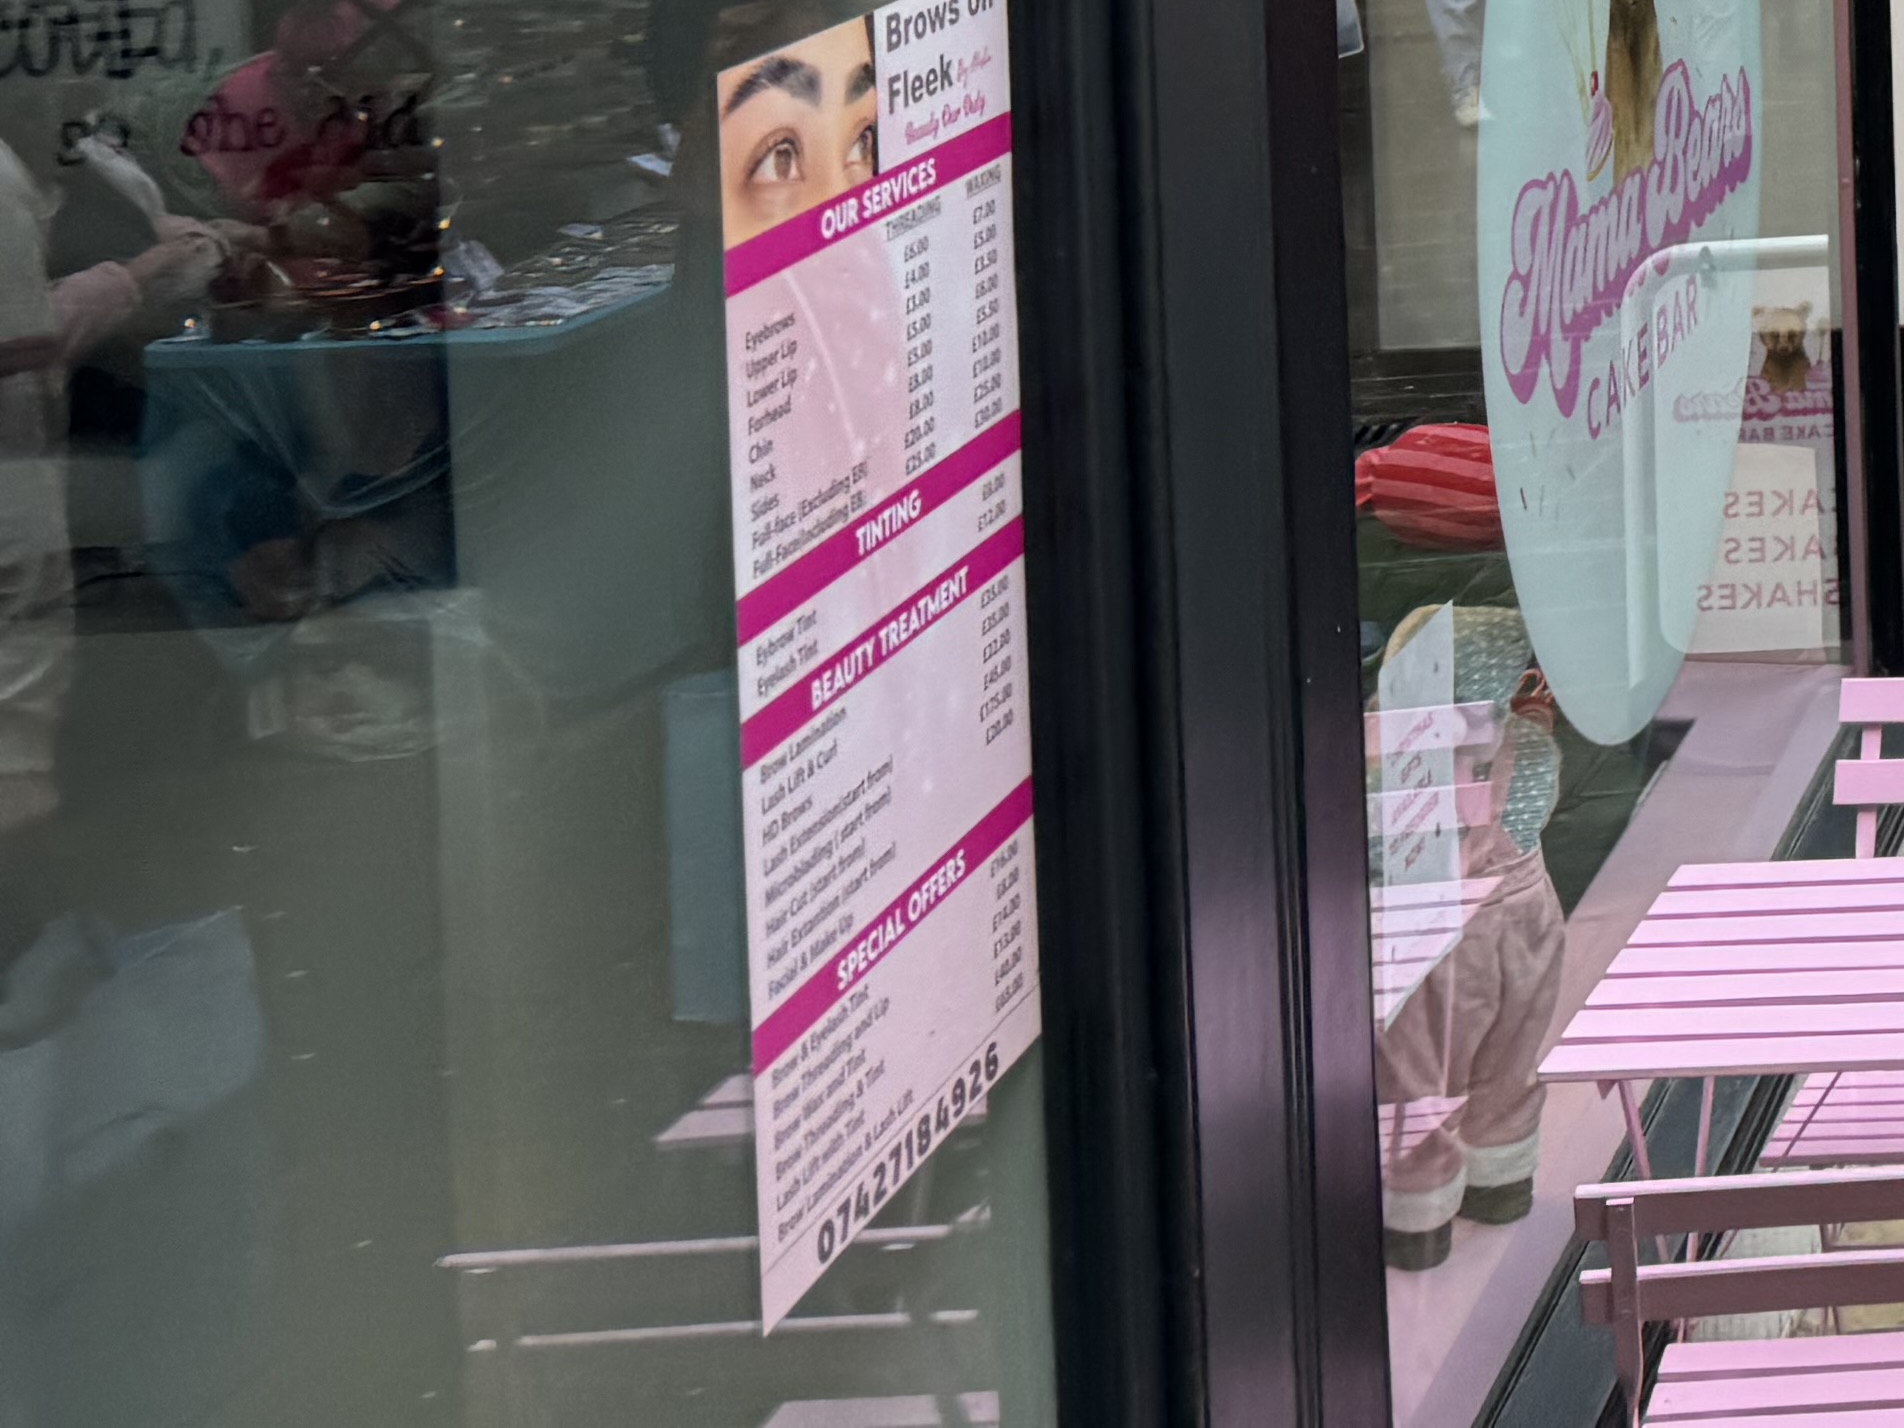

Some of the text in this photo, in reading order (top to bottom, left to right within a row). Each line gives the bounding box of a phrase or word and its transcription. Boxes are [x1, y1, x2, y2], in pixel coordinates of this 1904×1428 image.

[888, 55, 952, 113] Fleek
[821, 158, 935, 238] OUR SERVICES
[1501, 58, 1753, 420] Mama Bears
[1587, 273, 1701, 440] CAKE BAR
[856, 490, 920, 553] TINTING
[811, 567, 967, 708] BEAUTY TREATMENT
[837, 850, 964, 988] SPECIAL OFFERS
[818, 1043, 997, 1260] 07427184926
